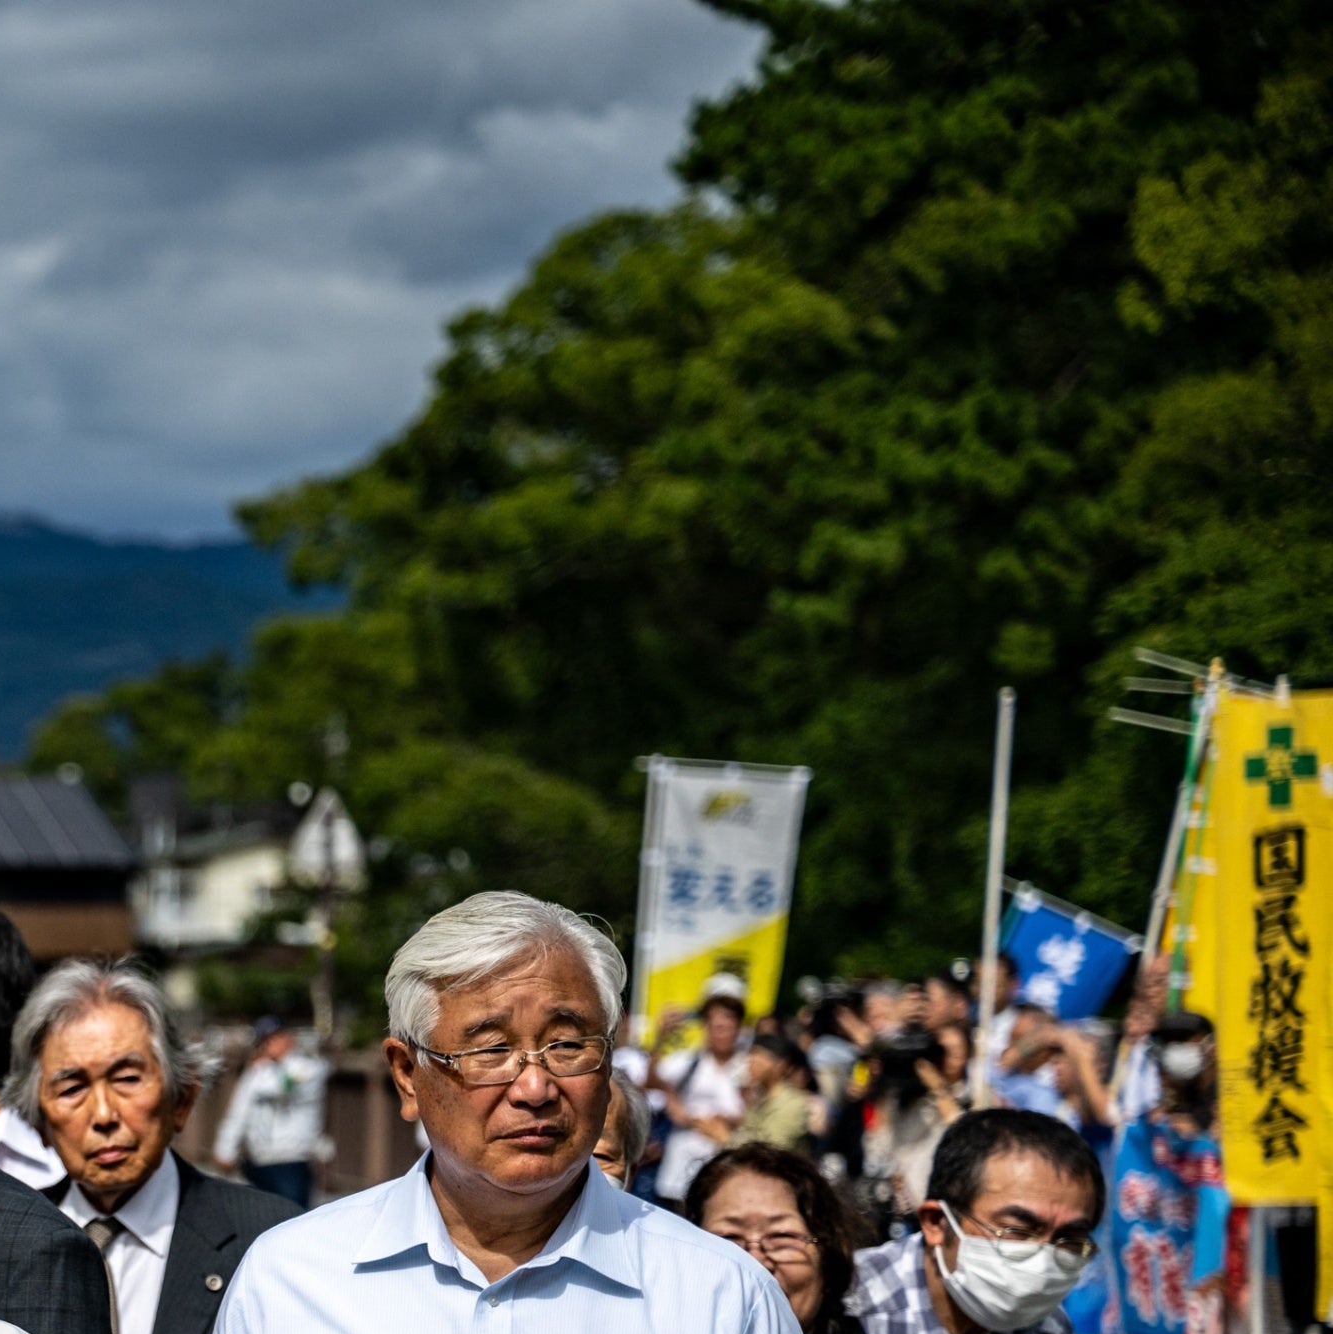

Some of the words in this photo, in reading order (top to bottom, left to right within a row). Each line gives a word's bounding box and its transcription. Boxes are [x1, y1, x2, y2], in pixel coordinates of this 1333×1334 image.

[1248, 826, 1311, 1166] 国民救援会
